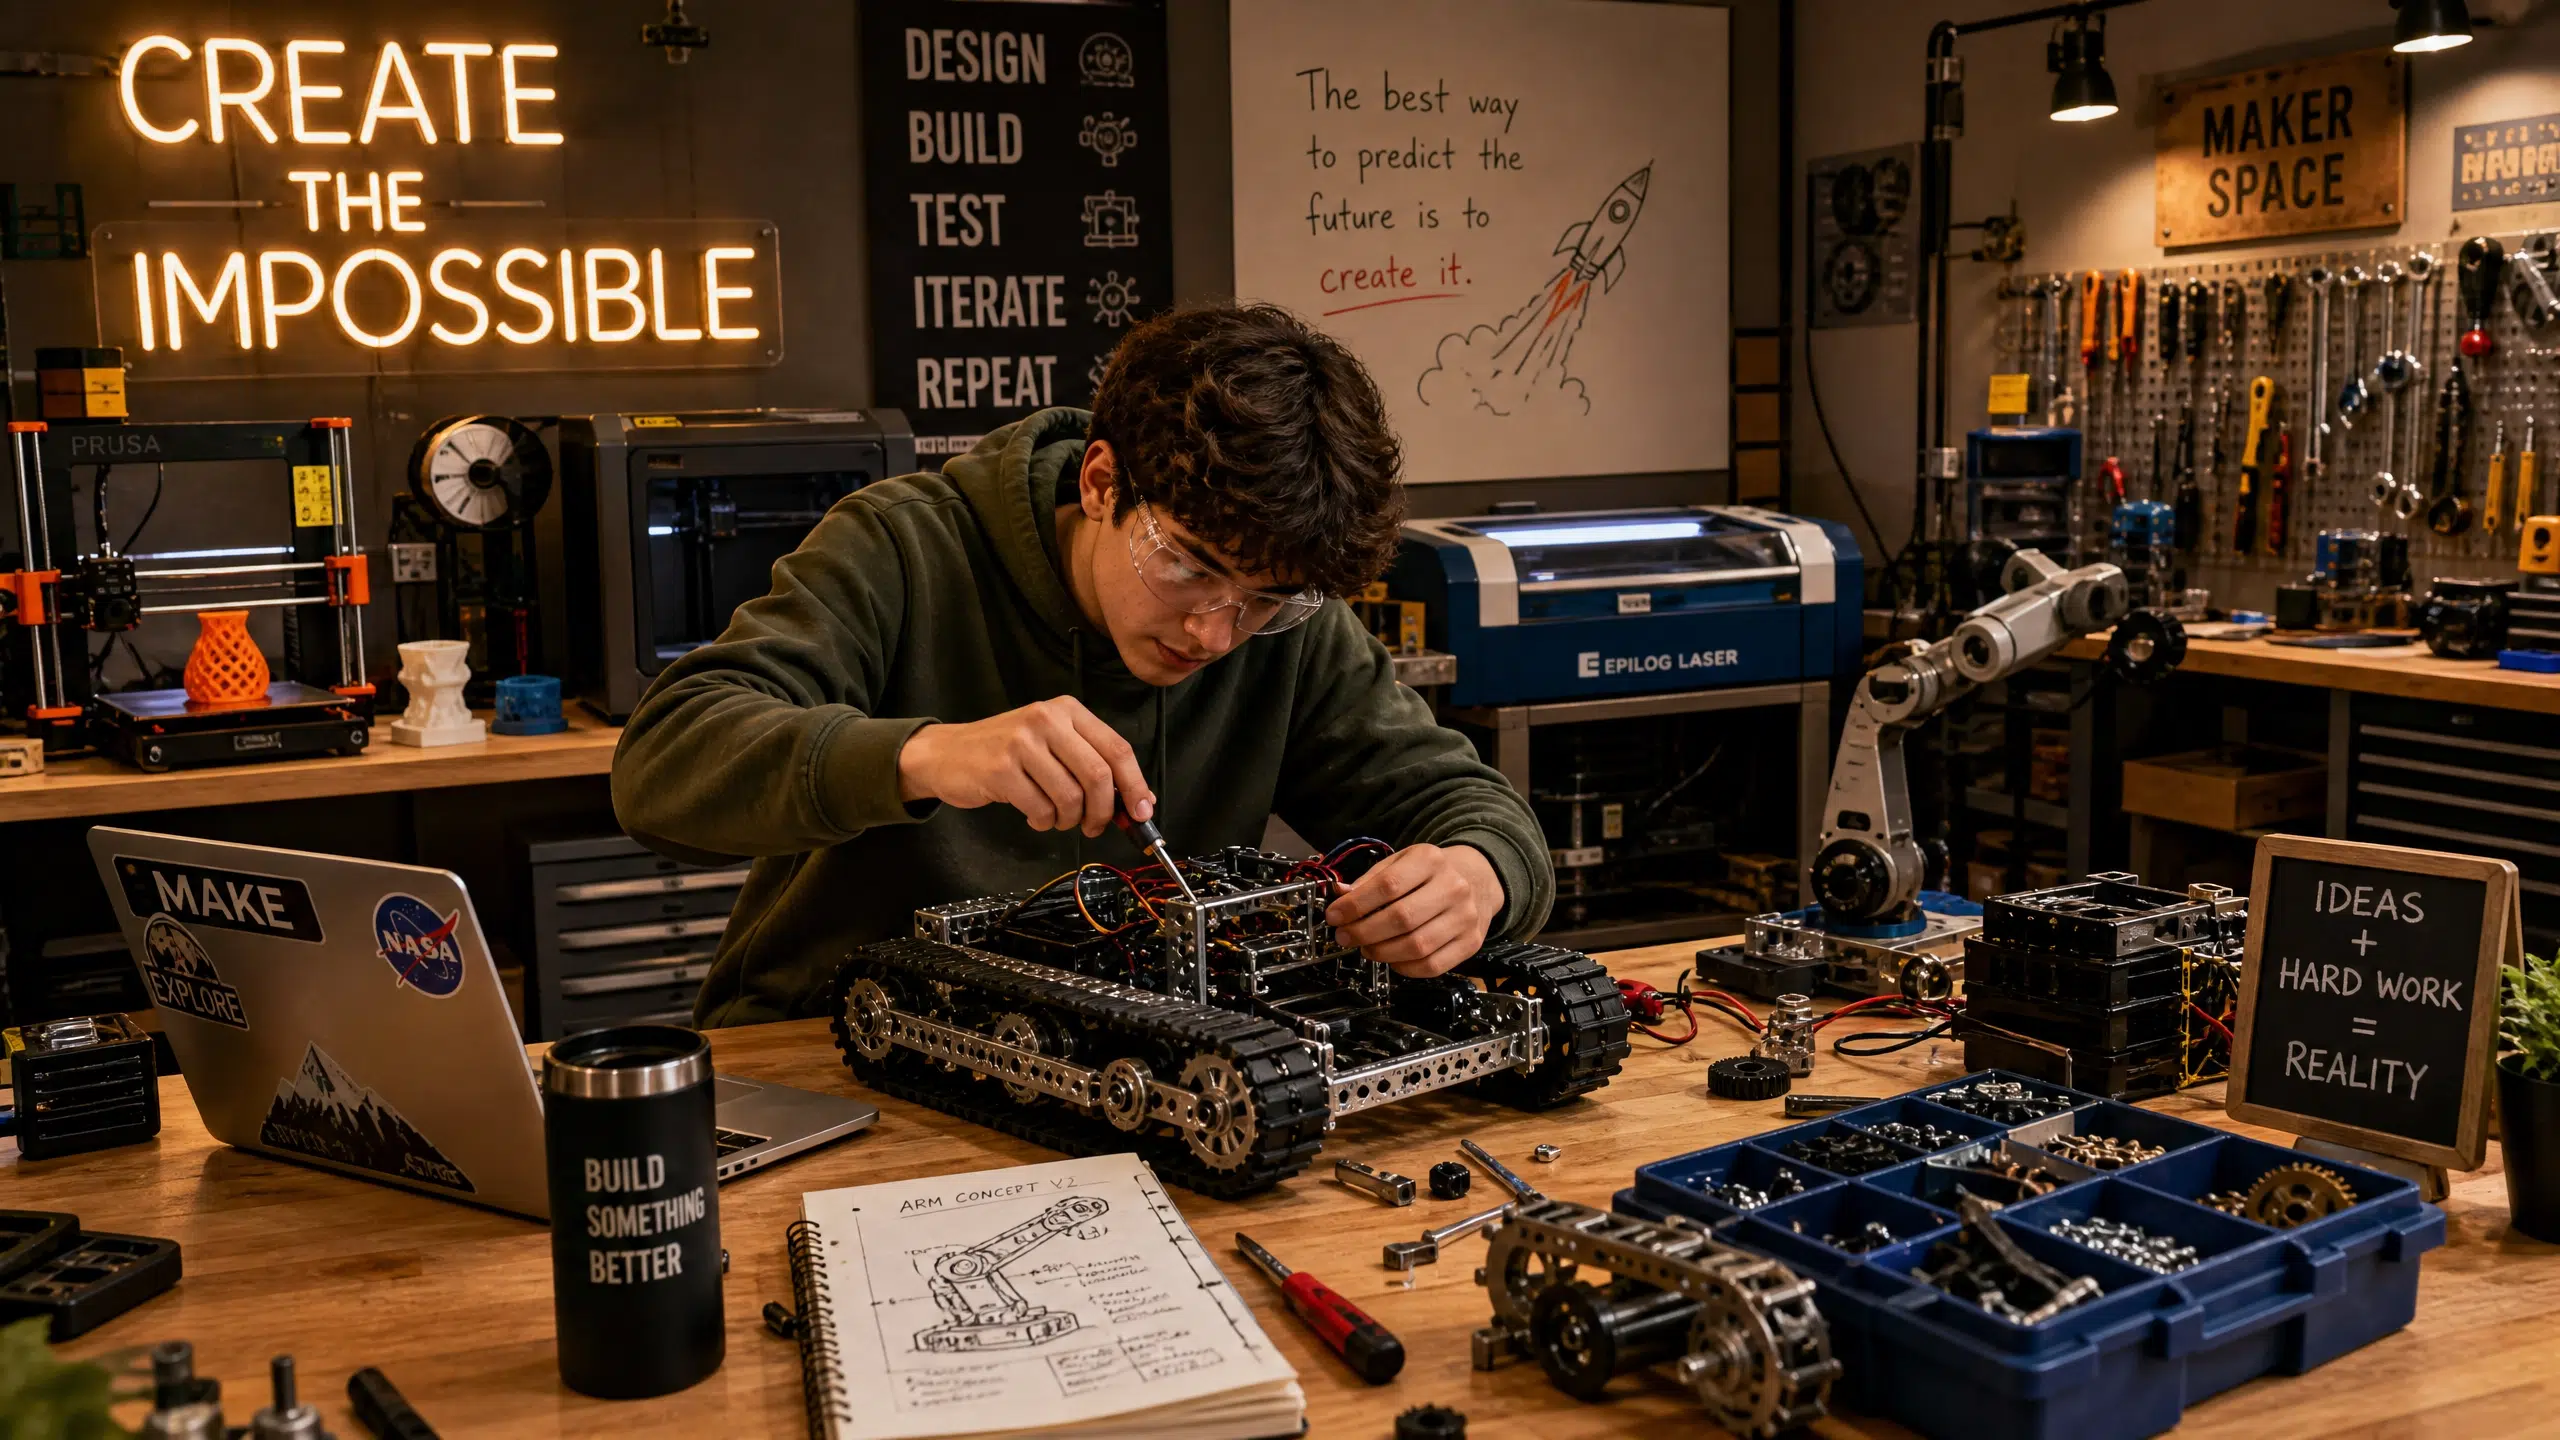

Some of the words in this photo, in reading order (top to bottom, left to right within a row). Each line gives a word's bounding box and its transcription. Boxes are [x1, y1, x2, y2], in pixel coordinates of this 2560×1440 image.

[905, 27, 1046, 84] DESIGN
[119, 34, 565, 146] CREATE
[1296, 67, 1360, 110] The
[1384, 70, 1450, 113] best
[1469, 96, 1519, 134] way
[909, 110, 1023, 164] BUILD
[2203, 85, 2353, 158] MAKER
[1306, 134, 1336, 169] to
[1359, 136, 1455, 184] predict
[1479, 137, 1524, 170] the
[2207, 152, 2345, 218] SPACE
[287, 170, 427, 233] THE
[910, 193, 1006, 246] TEST
[1305, 191, 1395, 236] future
[1418, 201, 1439, 228] is
[1462, 197, 1490, 228] to
[133, 246, 761, 352] IMPOSSIBLE
[1320, 255, 1416, 294] create
[1440, 252, 1471, 285] it.
[914, 275, 1067, 328] ITERATE
[917, 355, 1057, 409] REPEAT
[71, 434, 161, 457] PRUSA
[1605, 655, 1672, 674] EPILOG
[1678, 650, 1738, 669] LASER
[151, 870, 294, 931] MAKE
[2315, 880, 2424, 924] IDEAS
[382, 929, 458, 963] NASA
[150, 971, 245, 1025] EXPLORE
[2279, 957, 2363, 996] HARD
[2377, 970, 2463, 1012] WORK
[2285, 1040, 2429, 1101] REALITY
[584, 1154, 665, 1192] BUILD
[900, 1196, 943, 1213] ARM
[955, 1181, 1039, 1204] CONCEPT
[587, 1186, 705, 1238] SOMETHING
[589, 1242, 683, 1284] BETTER
